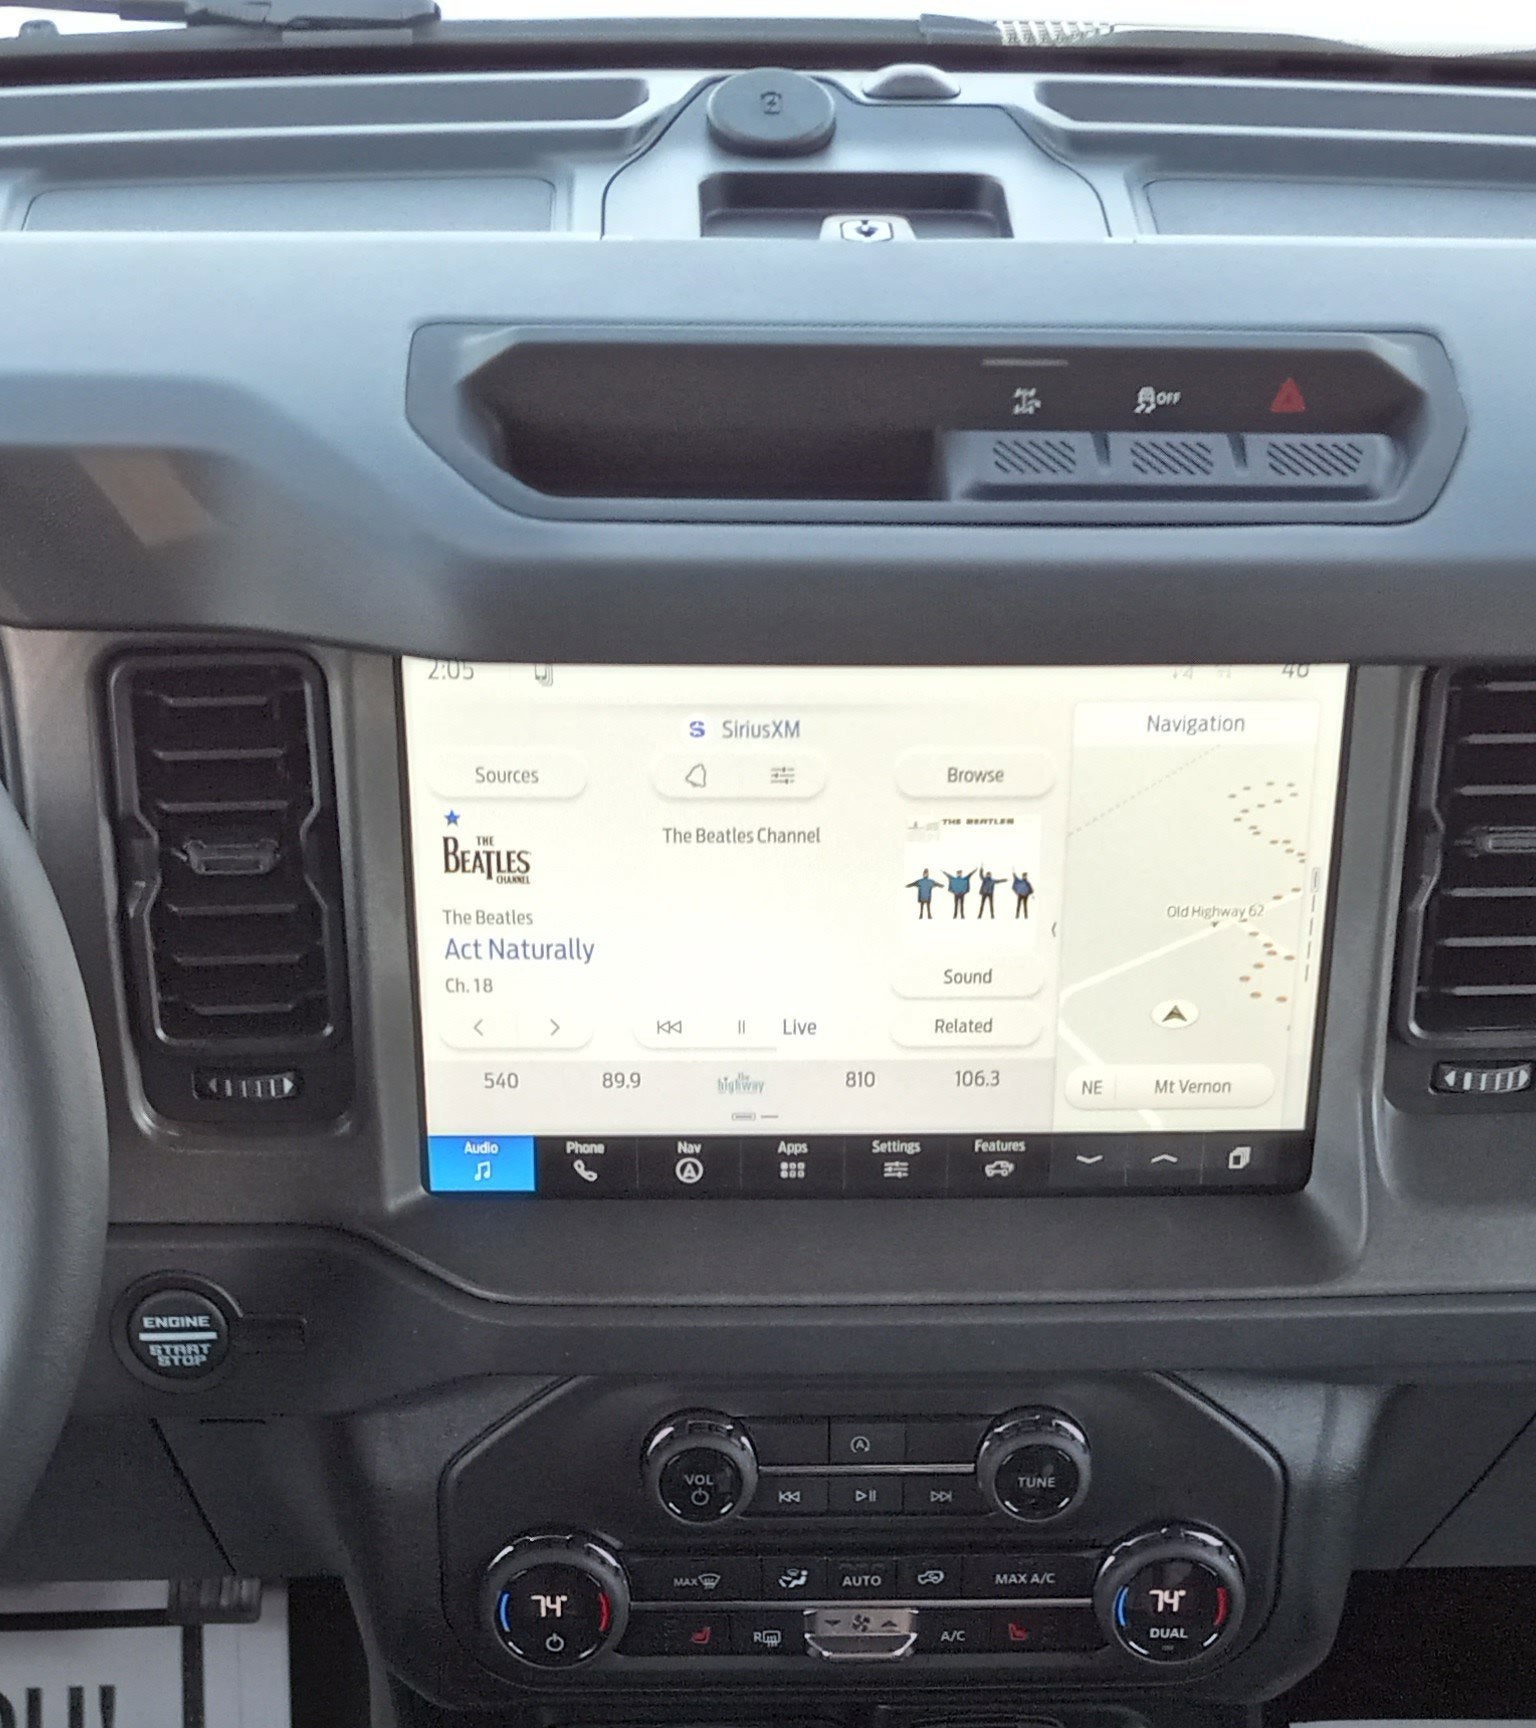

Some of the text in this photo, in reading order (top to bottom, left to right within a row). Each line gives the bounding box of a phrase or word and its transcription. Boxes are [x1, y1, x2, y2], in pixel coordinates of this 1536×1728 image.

[722, 719, 800, 739] SiriusXM
[1147, 714, 1245, 735] Navigation
[475, 766, 539, 784] Sources
[947, 767, 1004, 783] Browse
[476, 836, 495, 846] THE
[663, 826, 821, 844] The Beatles Channel
[443, 836, 531, 880] BEATLES
[496, 875, 531, 884] CHANNEL
[442, 908, 533, 925] The Beatles
[1167, 904, 1264, 920] Old Highway 62
[445, 937, 595, 964] Act Naturally
[943, 968, 993, 984] Sound
[445, 977, 493, 993] Ch. 18
[783, 1018, 818, 1036] Live
[934, 1018, 993, 1034] Related
[484, 1072, 519, 1089] 540
[602, 1072, 642, 1089] 89.9
[717, 1076, 765, 1095] highway
[845, 1071, 876, 1088] 810
[955, 1070, 1000, 1087] 106.3
[1081, 1080, 1103, 1095] NE
[1154, 1079, 1232, 1094] Mt Vernon
[464, 1141, 499, 1154] Audio
[566, 1141, 605, 1154] Phone
[677, 1141, 701, 1154] Nav
[777, 1141, 808, 1156] Apps
[872, 1139, 921, 1155] Settings
[974, 1138, 1026, 1152] Features
[142, 1315, 210, 1328] ENGINE
[148, 1343, 212, 1356] START
[157, 1354, 207, 1367] STOP
[684, 1474, 713, 1486] VOL
[1018, 1476, 1057, 1488] TUNE
[673, 1576, 698, 1588] MAX
[842, 1575, 881, 1587] AUTO
[995, 1572, 1056, 1585] MAX A/C
[940, 1630, 965, 1642] A/C
[1149, 1627, 1188, 1639] DUAL
